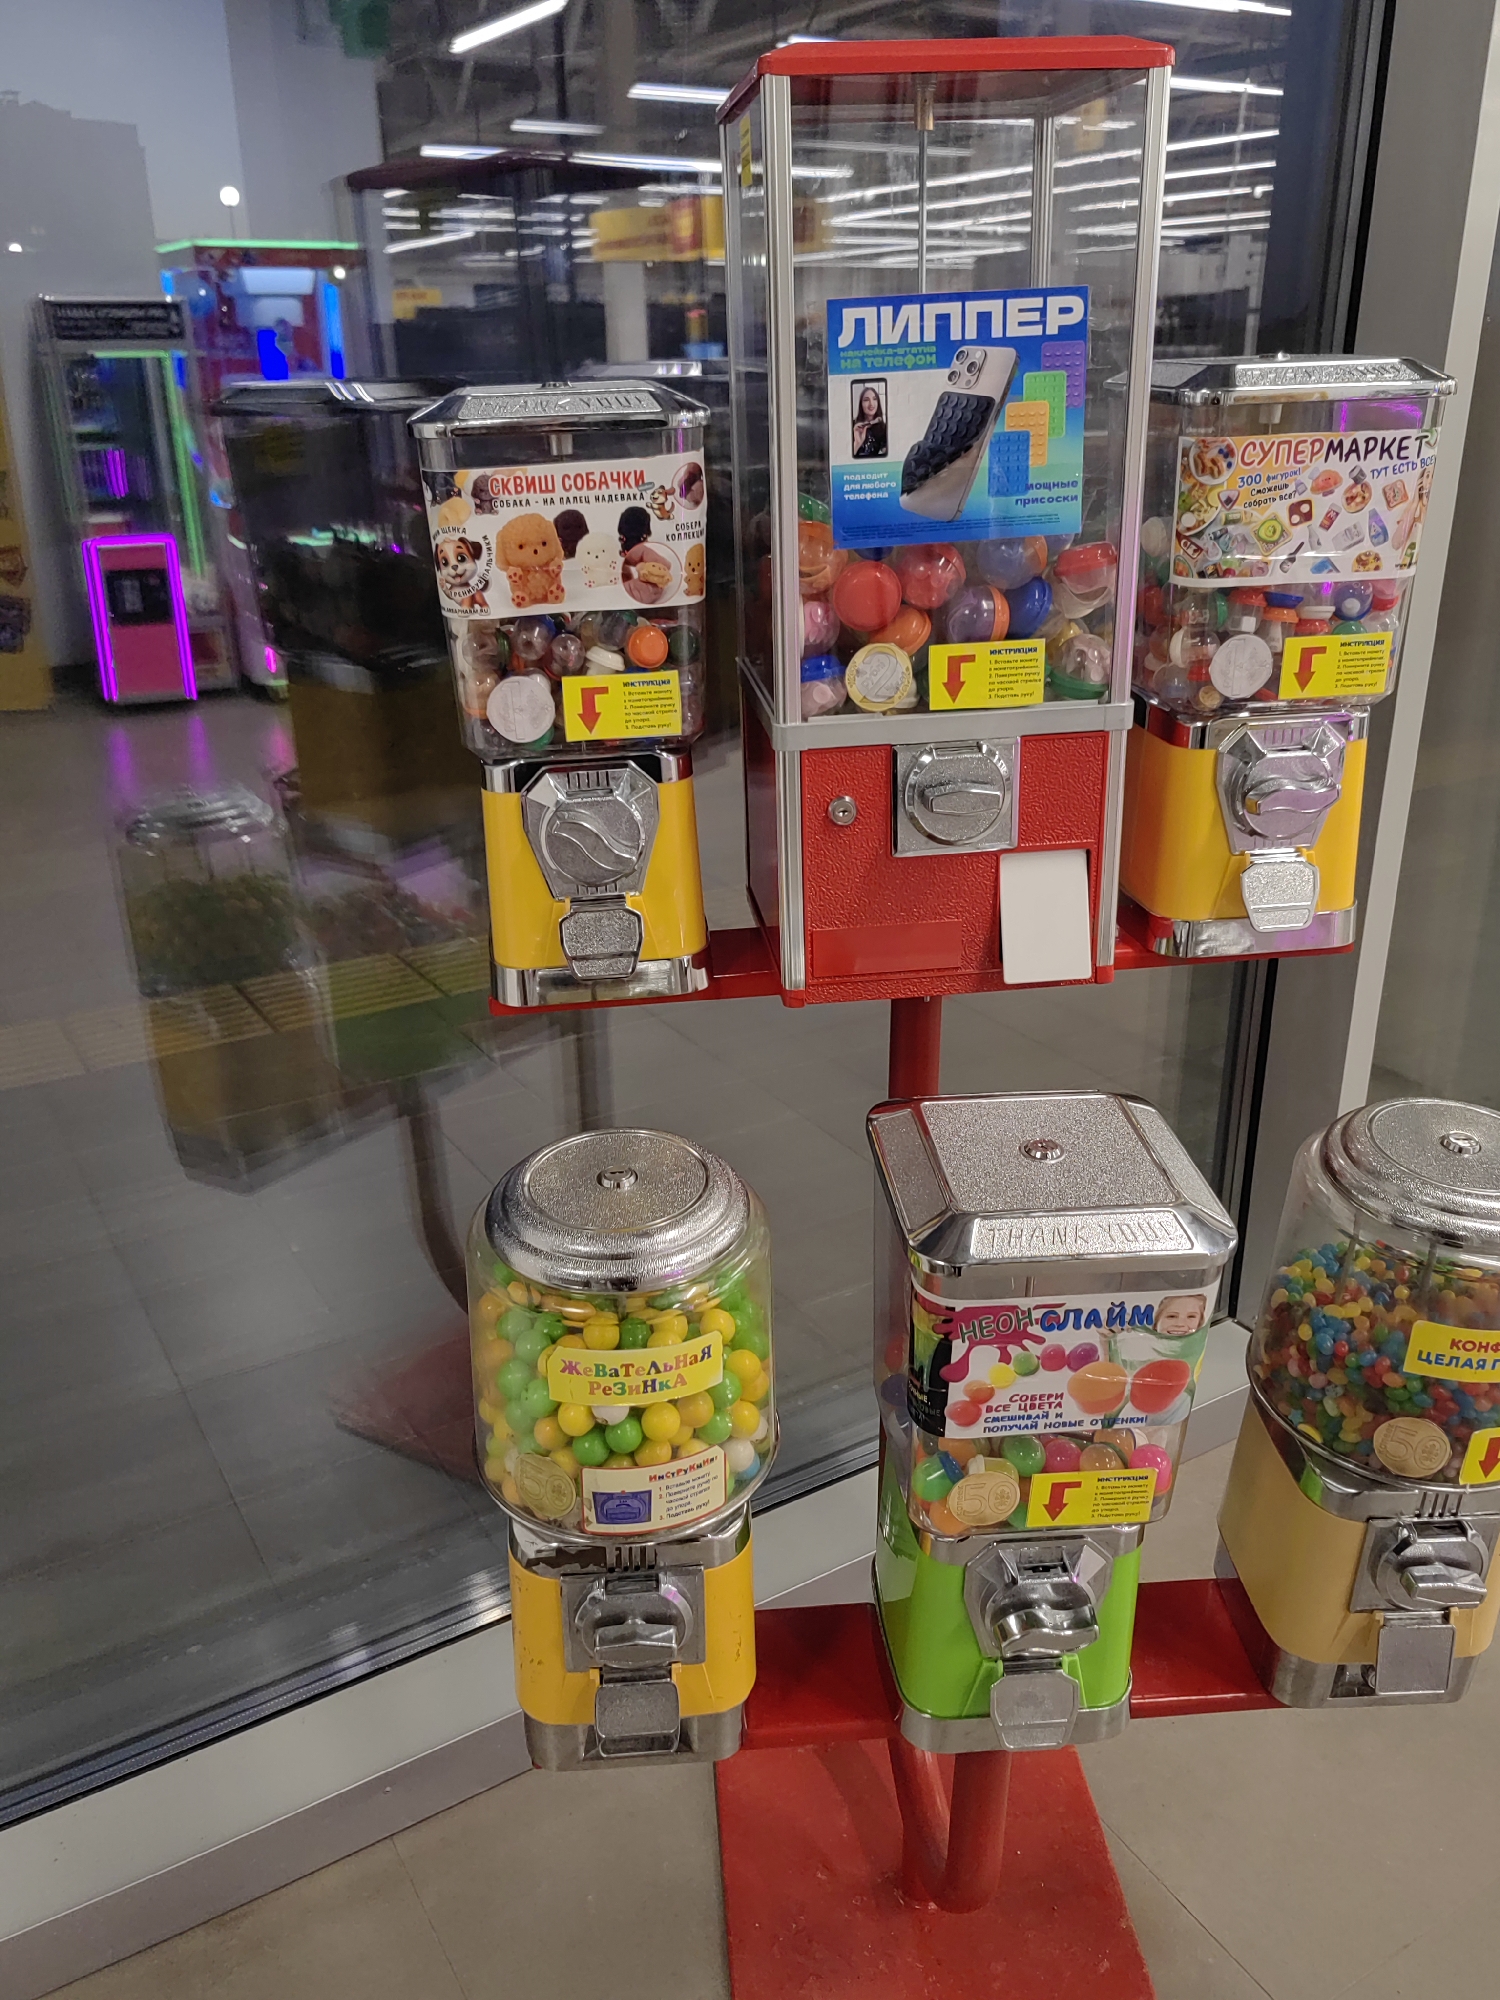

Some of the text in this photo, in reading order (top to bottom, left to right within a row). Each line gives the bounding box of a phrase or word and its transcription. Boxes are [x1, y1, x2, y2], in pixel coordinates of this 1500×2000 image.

[837, 295, 1085, 349] ЛИППЕР
[841, 354, 937, 369] на телефон
[1239, 435, 1429, 466] СУПЕРМАРКЕТ
[1370, 466, 1389, 479] ТУТ
[1392, 461, 1417, 475] ЕСТЬ
[490, 470, 646, 497] СКВИШ СОБАЧКИ
[862, 481, 897, 490] любого
[1025, 478, 1079, 492] мощные
[1238, 473, 1262, 488] 300
[844, 492, 888, 500] телефона
[1250, 483, 1289, 497] Сможешь
[493, 498, 531, 509] СОБАКА
[543, 497, 555, 506] НА
[559, 495, 591, 505] ПАЛЕЦ
[595, 492, 645, 503] НАДЕВАКА
[1015, 494, 1079, 508] присоски
[1244, 497, 1277, 508] собрать
[990, 647, 1038, 655] ИНСТРУКЦИЯ
[622, 679, 671, 687] ИНСТРУКЦИЯ
[988, 1220, 1176, 1249] THANK YOU!
[959, 1301, 1155, 1343] НЕОН СЛАЙМ
[1417, 1350, 1487, 1371] ЦЕЛАЯ
[1009, 1392, 1064, 1403] СОБЕРИ
[985, 1401, 1063, 1414] ВСЕ ЦВЕТА
[983, 1411, 1049, 1424] СМЕШИВАЙ
[983, 1421, 1038, 1433] ПОЛУЧАЙ
[1044, 1419, 1085, 1429] НОВЫЕ
